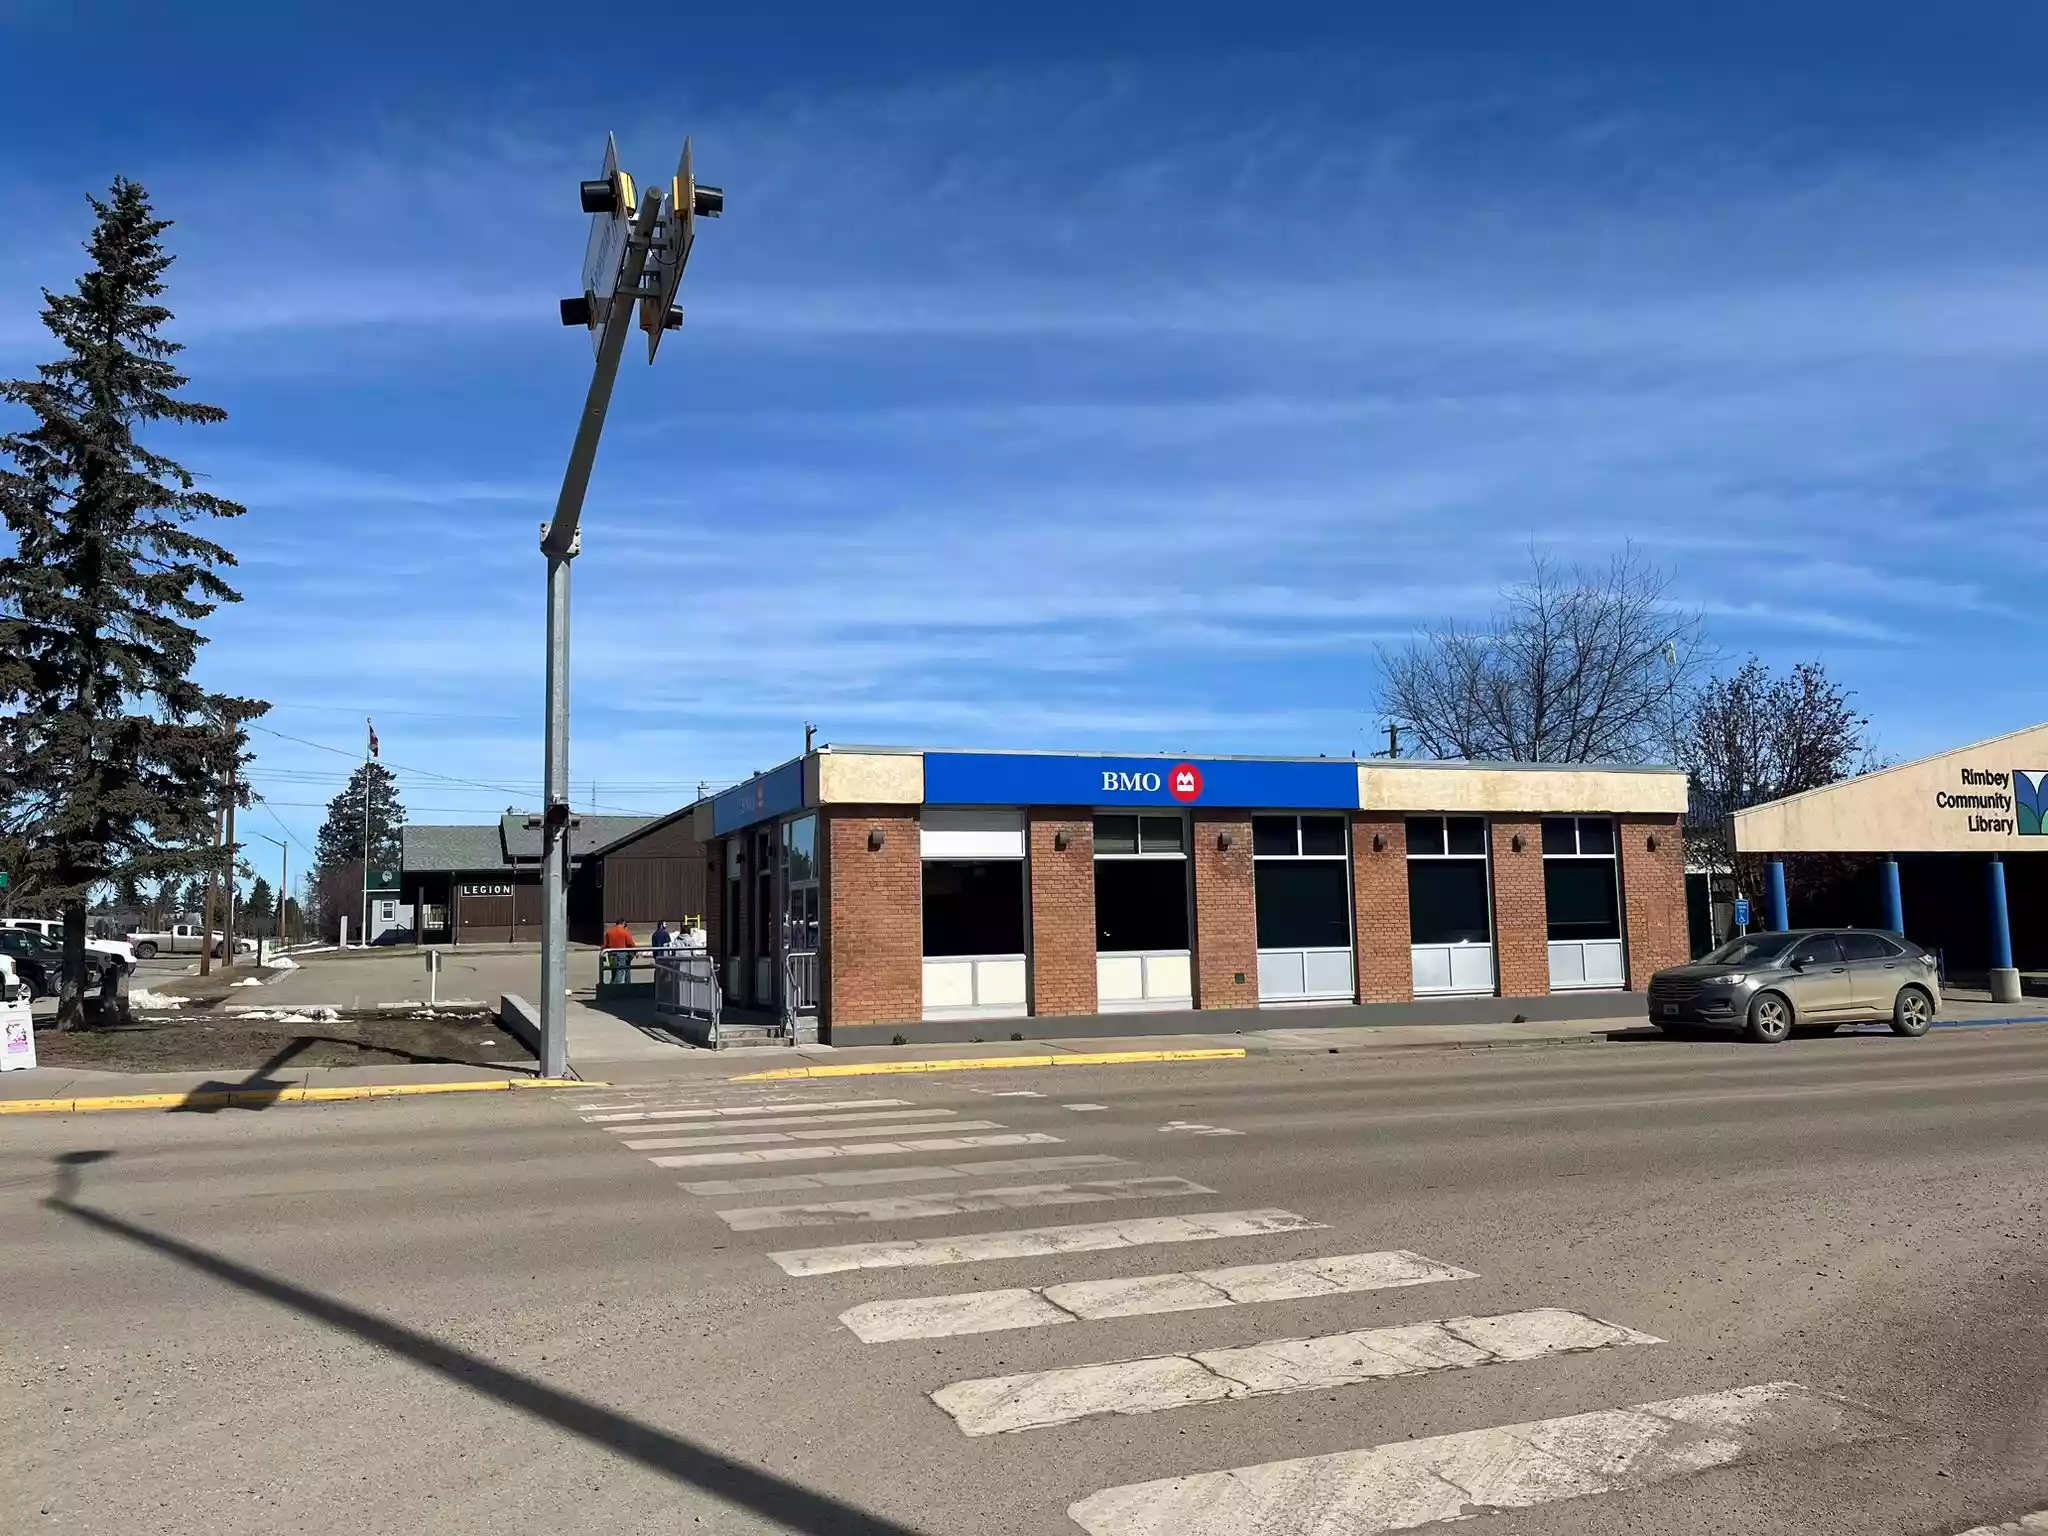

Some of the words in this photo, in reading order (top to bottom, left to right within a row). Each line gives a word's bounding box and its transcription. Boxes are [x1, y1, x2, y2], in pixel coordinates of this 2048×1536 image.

[1102, 771, 1161, 792] BMO
[1961, 768, 2009, 789] Rimbey
[1936, 791, 2012, 812] Community
[1968, 815, 2014, 836] Library
[463, 885, 511, 894] LEGION
